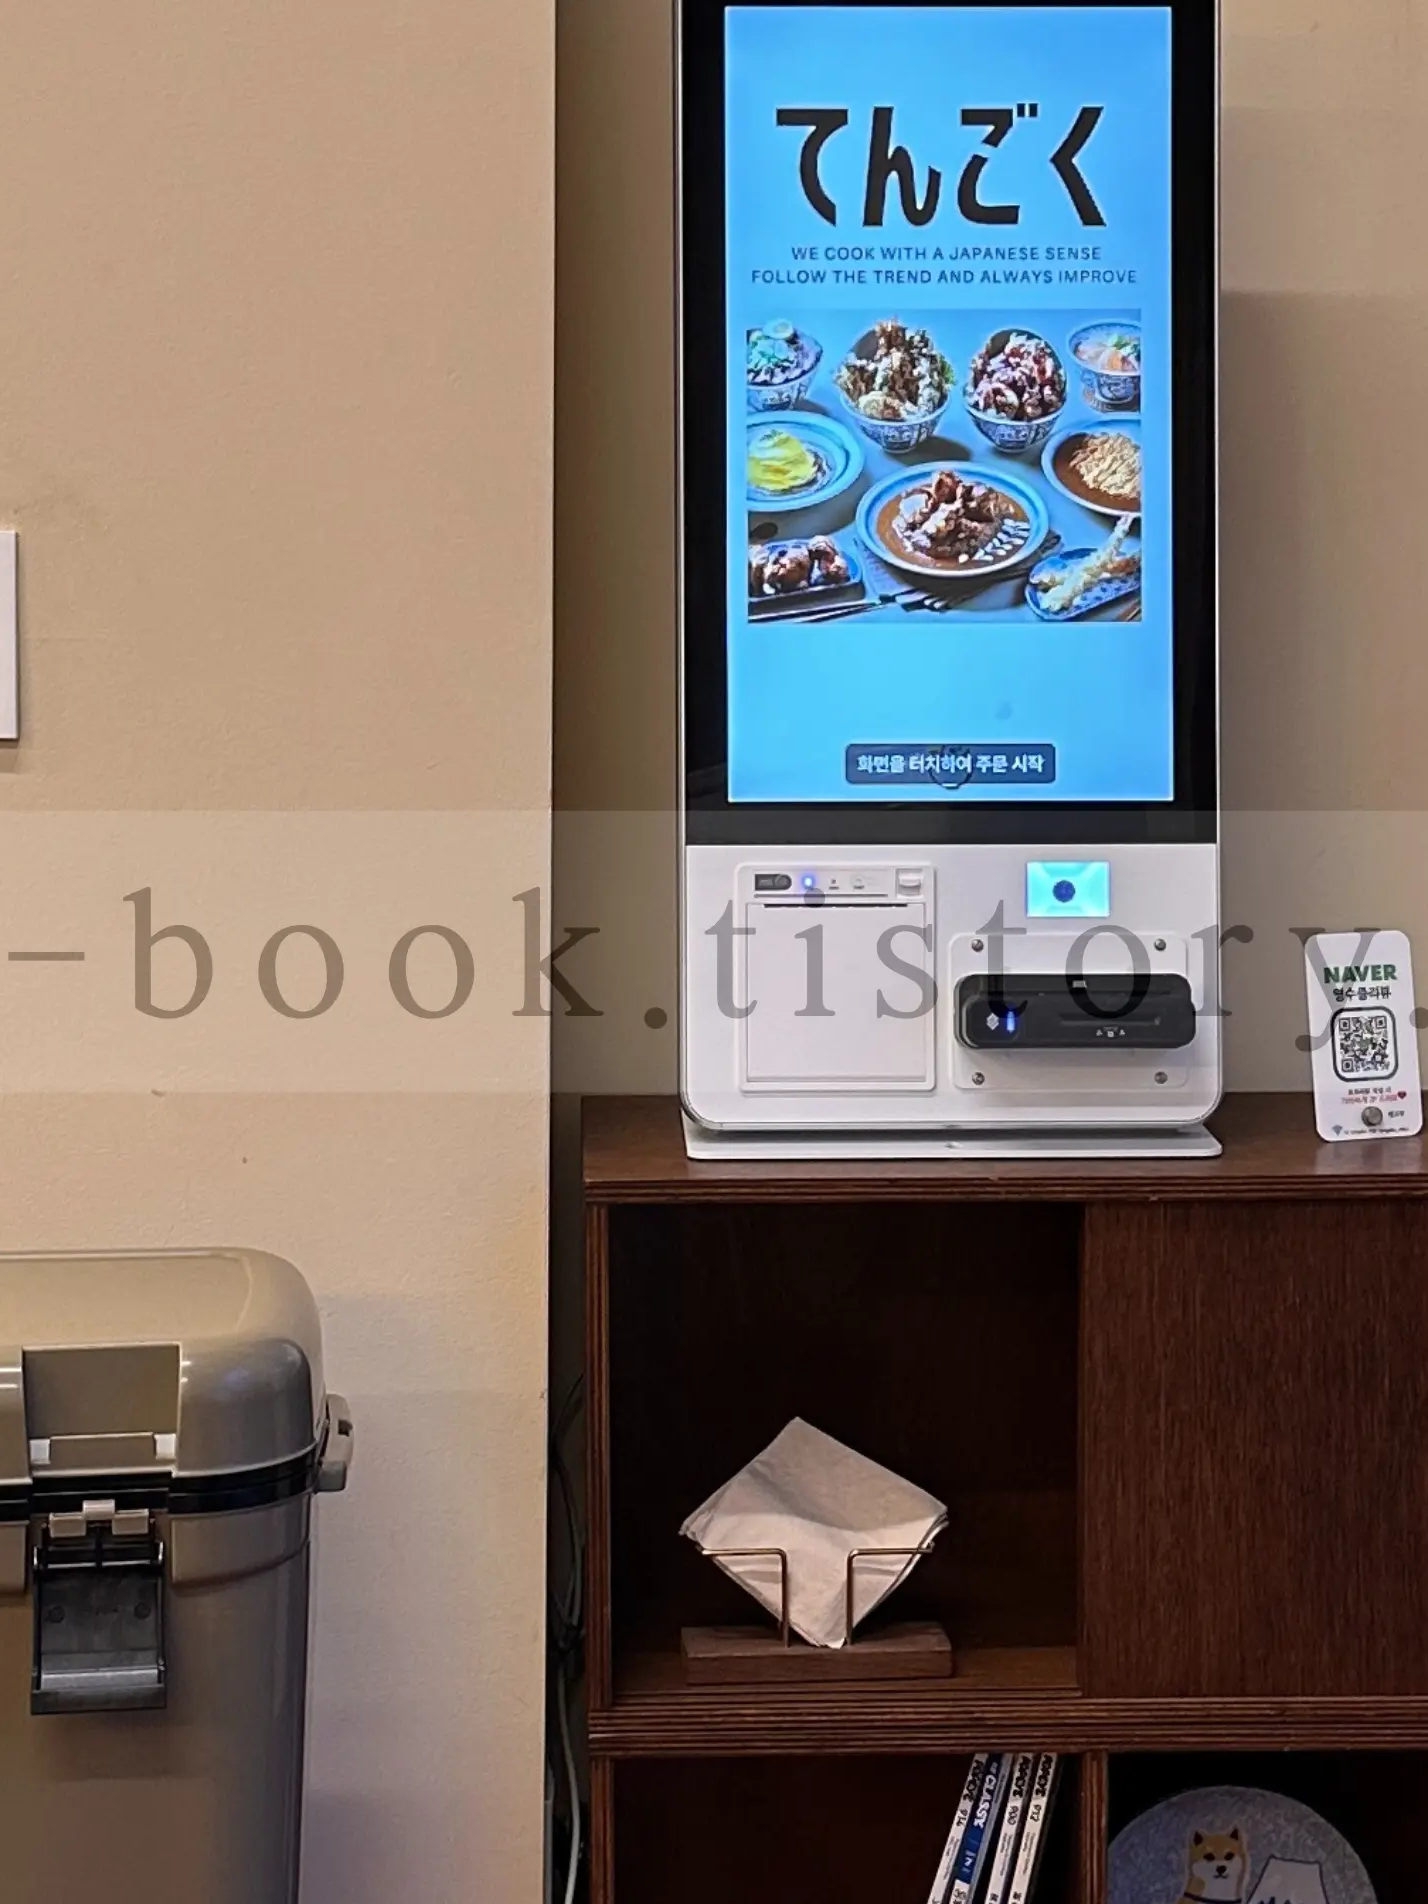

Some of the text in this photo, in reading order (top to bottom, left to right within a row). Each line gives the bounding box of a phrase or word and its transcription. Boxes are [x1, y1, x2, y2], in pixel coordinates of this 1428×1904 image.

[775, 102, 1107, 227] てんごく
[791, 246, 1102, 261] WE COOK WITH A JAPANESE SENSE
[751, 269, 1137, 285] FOLLOW THE TREND AND ALWAYS IMPROVE
[856, 753, 1045, 774] 화면을 터치하여 주문 시작
[1323, 964, 1398, 984] NAVER
